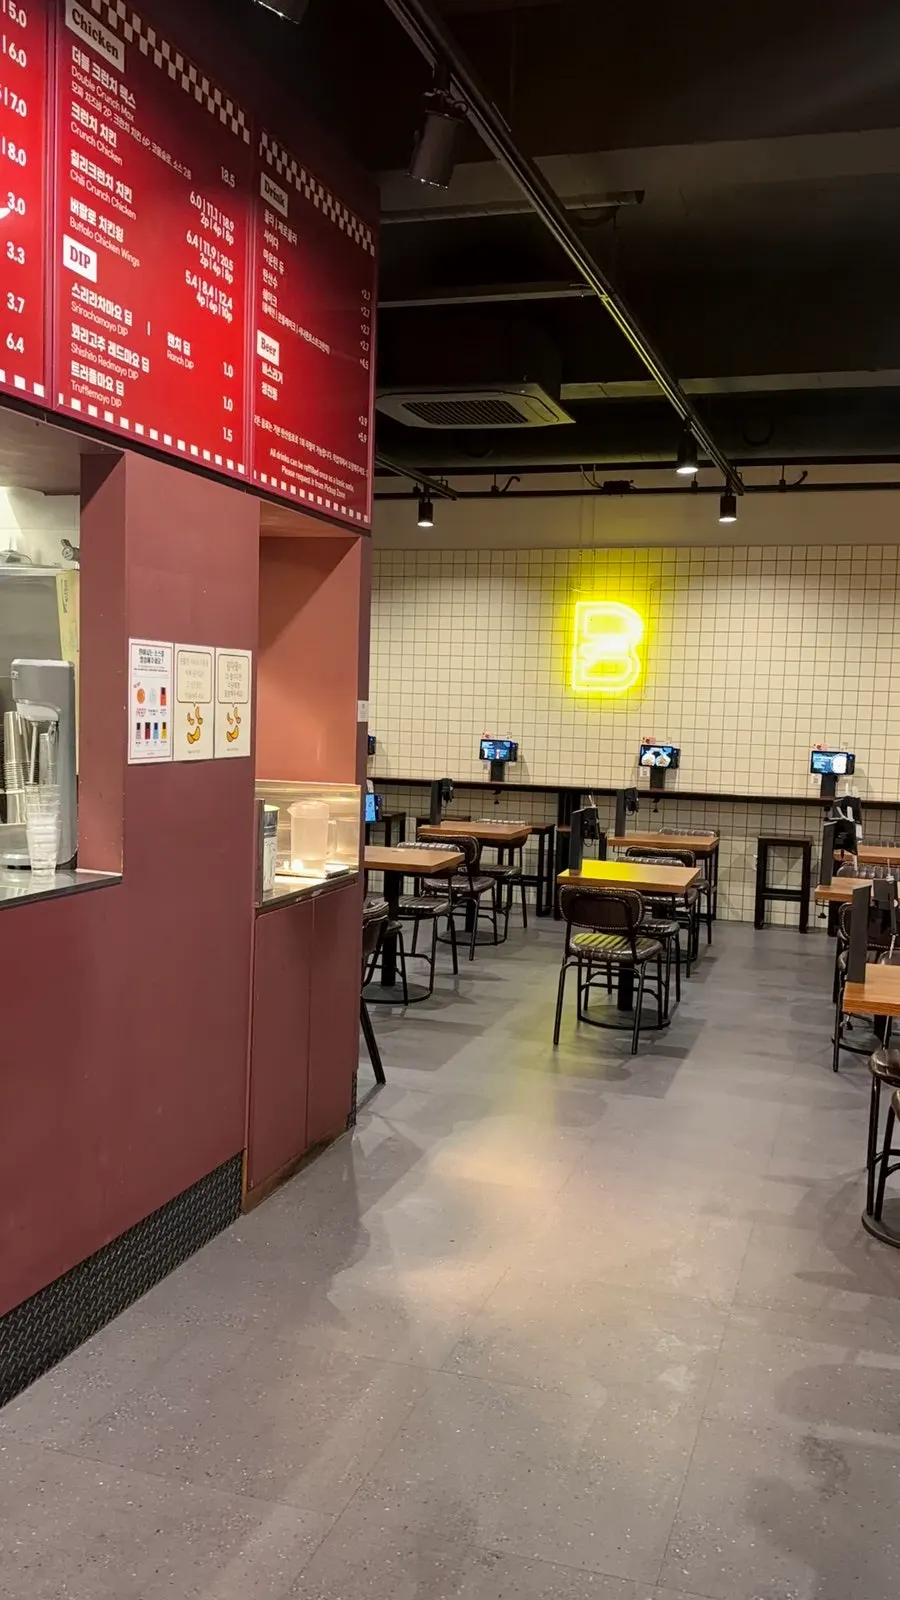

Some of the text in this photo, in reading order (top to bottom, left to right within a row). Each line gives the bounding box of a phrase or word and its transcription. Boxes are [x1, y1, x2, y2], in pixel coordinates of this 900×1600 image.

[8, 1, 27, 28] 5.0
[71, 8, 119, 60] Chicken
[8, 42, 27, 68] 6.0
[72, 45, 90, 73] 더블
[92, 62, 118, 95] 크런치
[10, 92, 27, 117] 7.0
[71, 65, 134, 122] Double Crunch Max
[71, 101, 117, 148] 크런치 치킨
[8, 142, 27, 166] 8.0
[71, 121, 123, 166] Crunch Chicken
[7, 191, 26, 216] 3.0
[70, 169, 137, 220] Chili Crunch Chicken
[116, 180, 132, 204] 치킨
[264, 180, 285, 208] Drink
[69, 215, 140, 268] Buffalo Chicken Wings
[98, 215, 124, 243] 치킨윙
[6, 241, 25, 265] 3.3
[69, 245, 91, 269] DIP
[6, 292, 25, 314] 3.7
[70, 301, 128, 338] Srirachamayo DIP
[6, 333, 25, 354] 6.4
[261, 337, 277, 356] Beer
[97, 355, 127, 377] Redmayo
[127, 368, 139, 381] DIP
[166, 349, 195, 370] Ranch DIP
[223, 361, 234, 378] 1.0
[70, 379, 122, 408] Trufflemayo DIP
[223, 396, 233, 412] 1.0
[222, 427, 233, 442] 1.5
[572, 601, 645, 691] B
